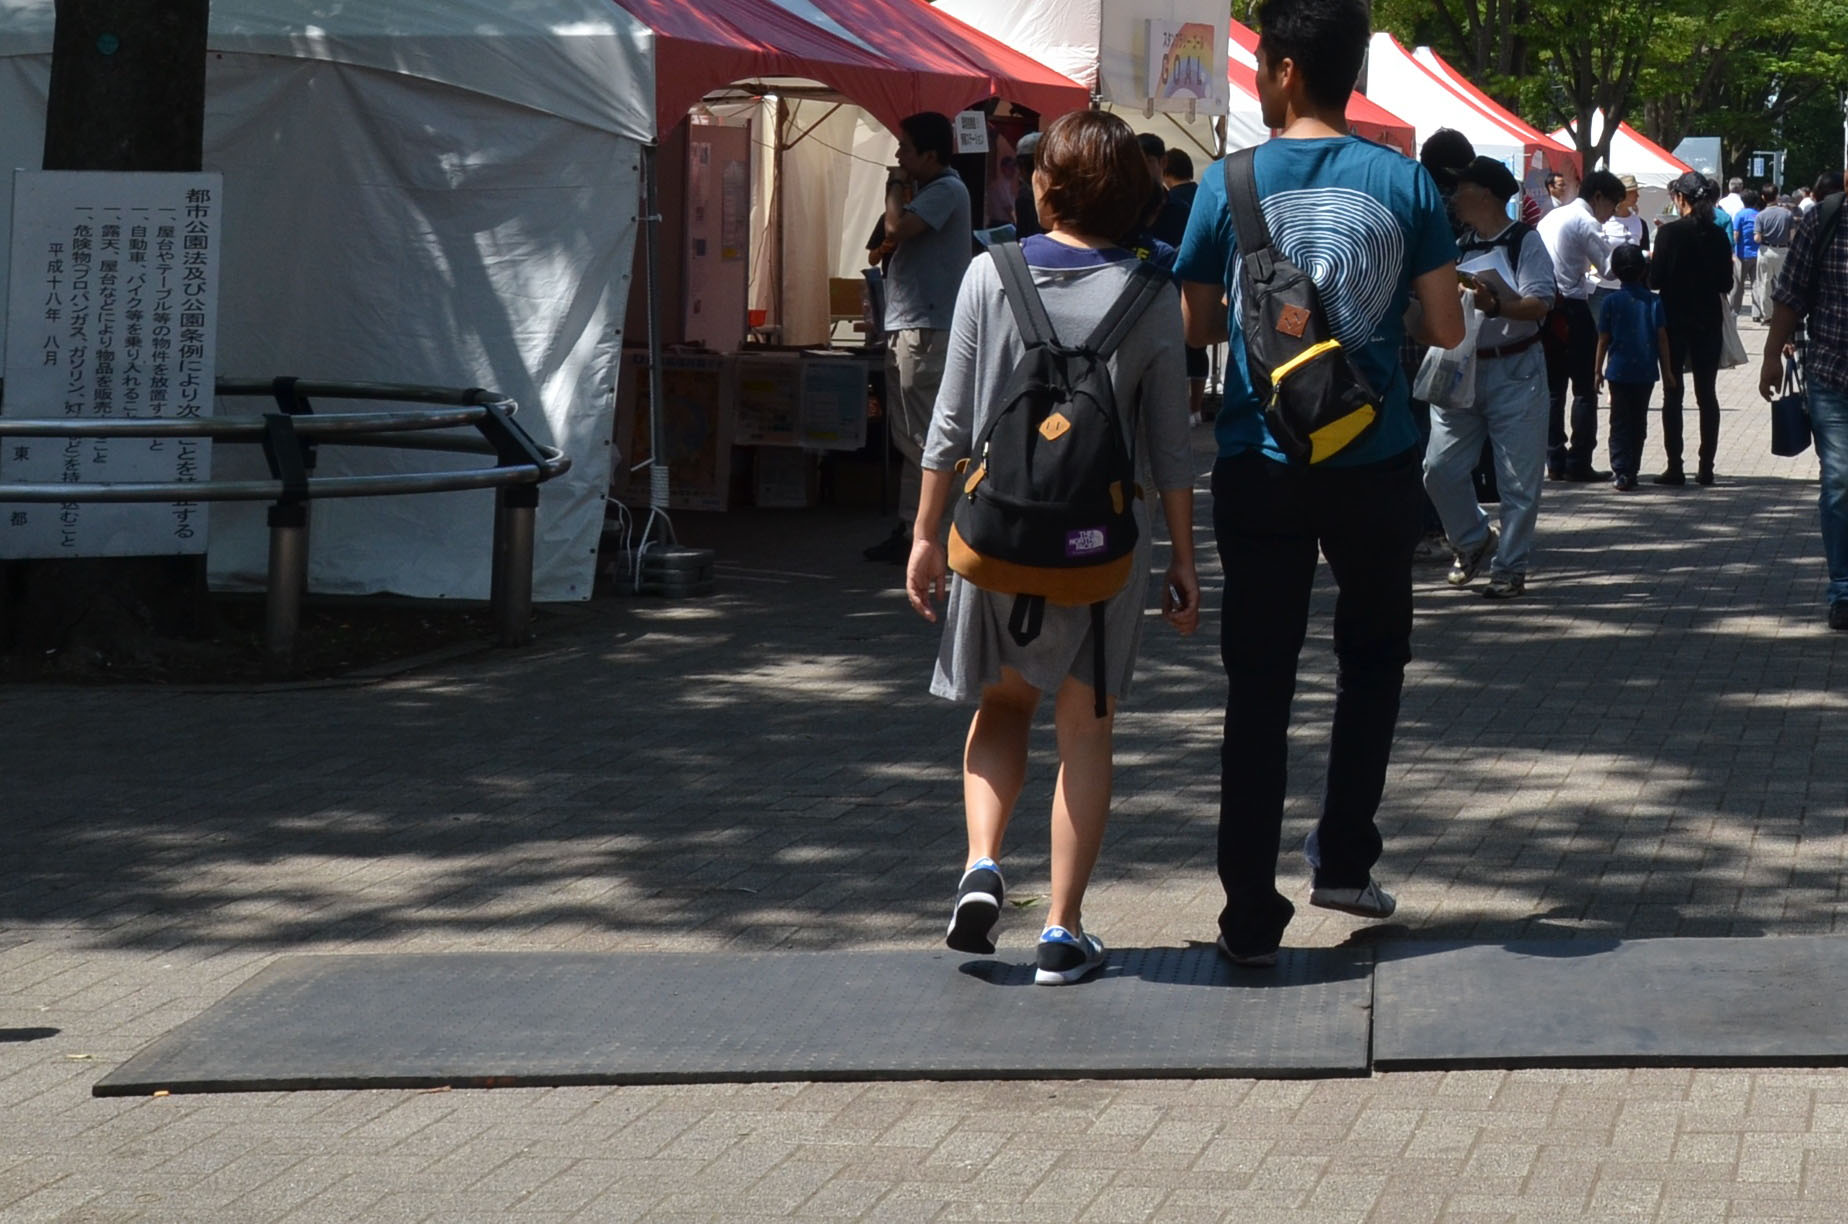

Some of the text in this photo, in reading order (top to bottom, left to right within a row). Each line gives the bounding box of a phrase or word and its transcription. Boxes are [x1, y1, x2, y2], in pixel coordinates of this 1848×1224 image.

[1161, 53, 1203, 86] GOAL
[92, 207, 121, 464] 一、露天、屋台などにより物品を販売こと
[149, 207, 176, 451] 一、屋台やテーブル等の物件を放置すと
[173, 188, 211, 539] 都市公園法及び公園条例により次とをする
[9, 446, 30, 527] 東都
